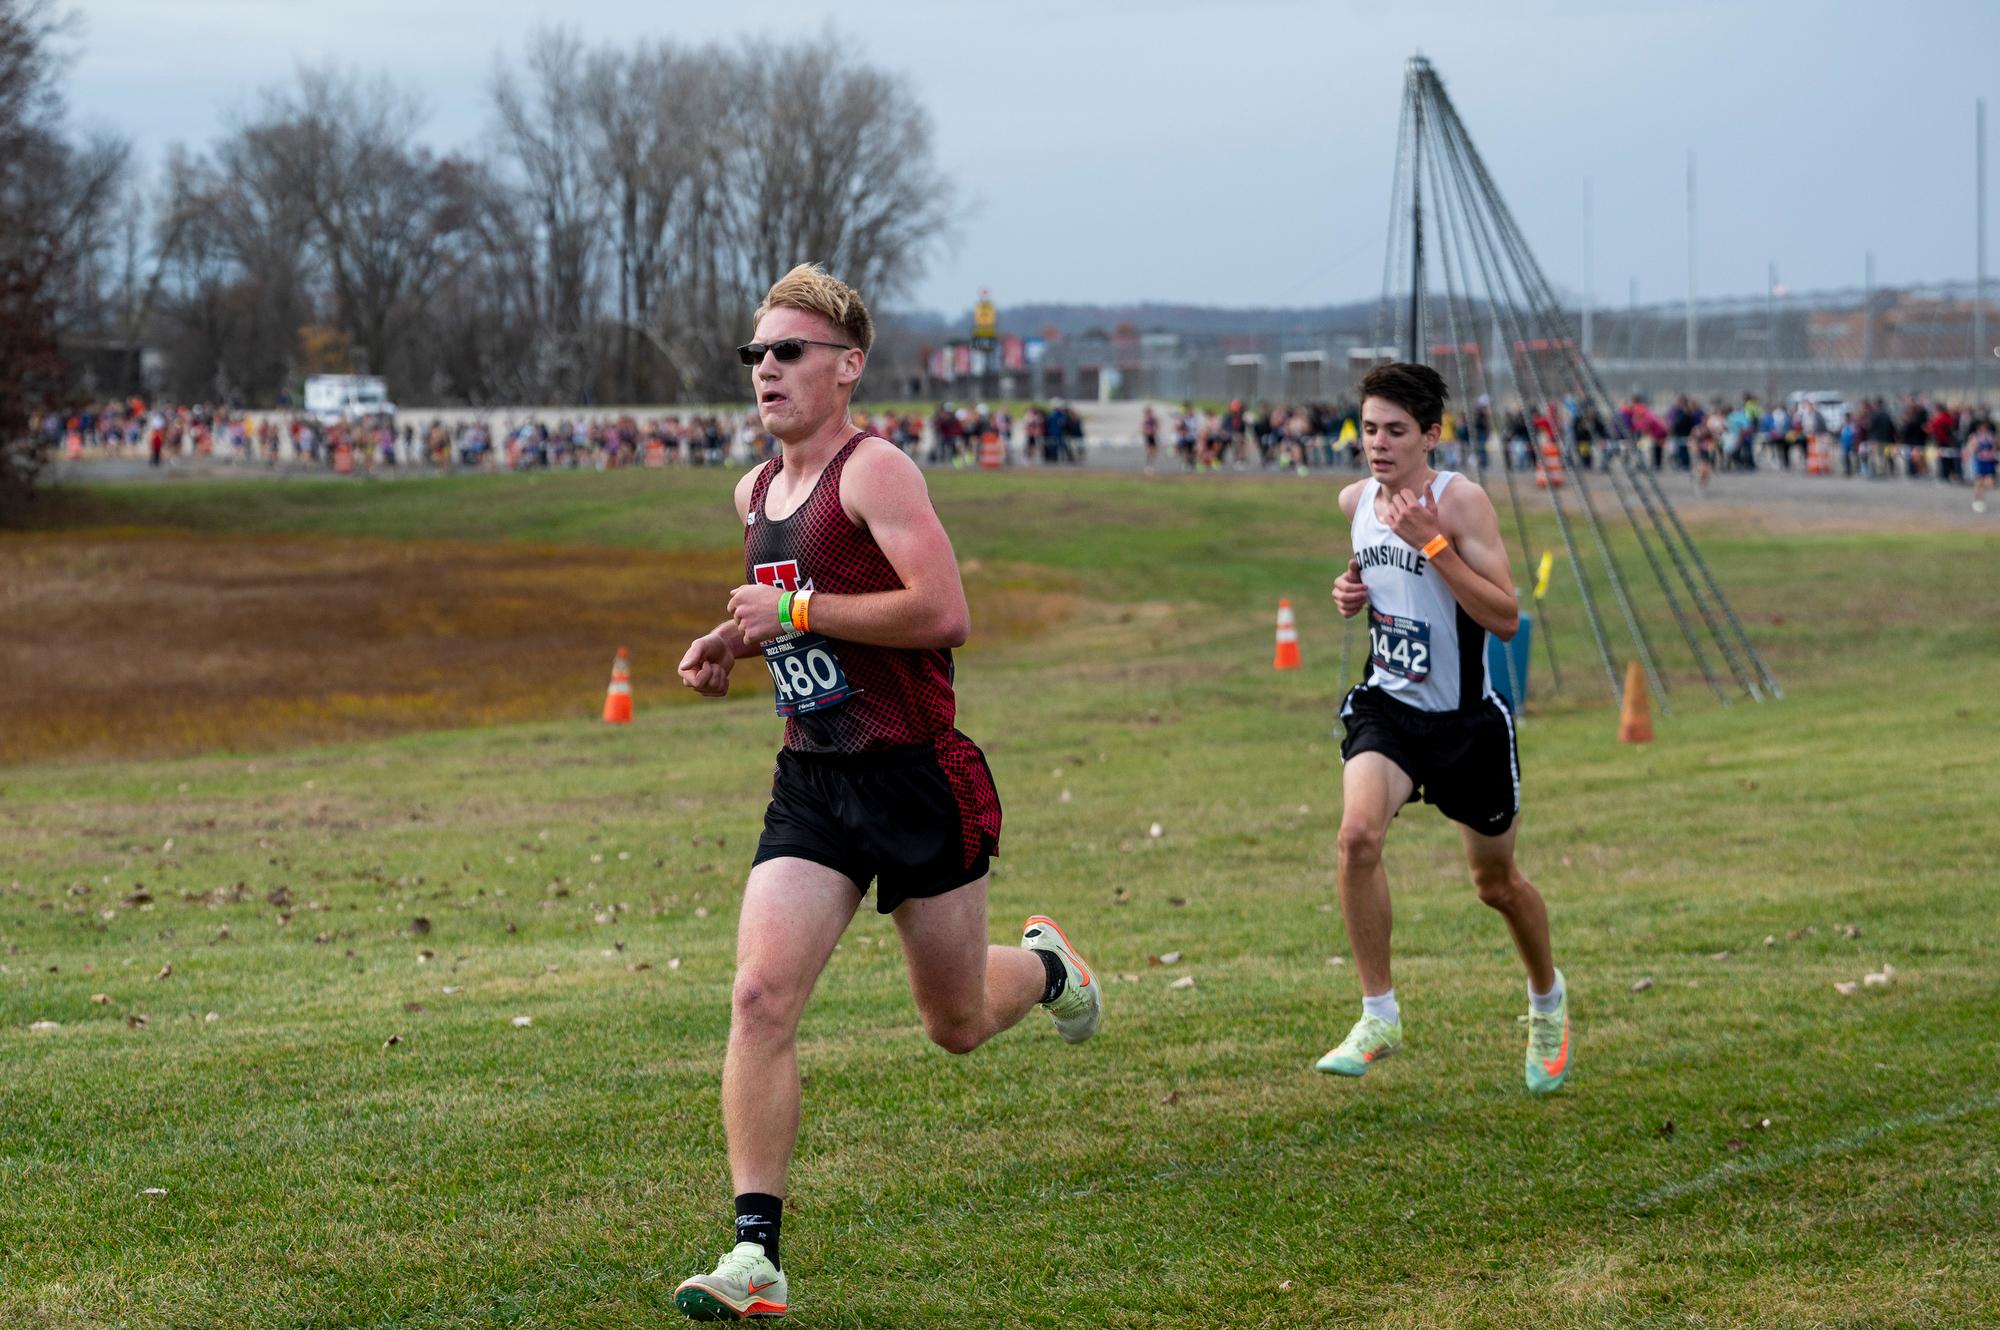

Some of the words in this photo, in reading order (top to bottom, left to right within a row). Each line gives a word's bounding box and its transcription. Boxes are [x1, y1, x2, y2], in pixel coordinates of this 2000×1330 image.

[766, 647, 780, 656] 2022
[778, 642, 795, 653] FINAL
[1369, 627, 1428, 673] 1442
